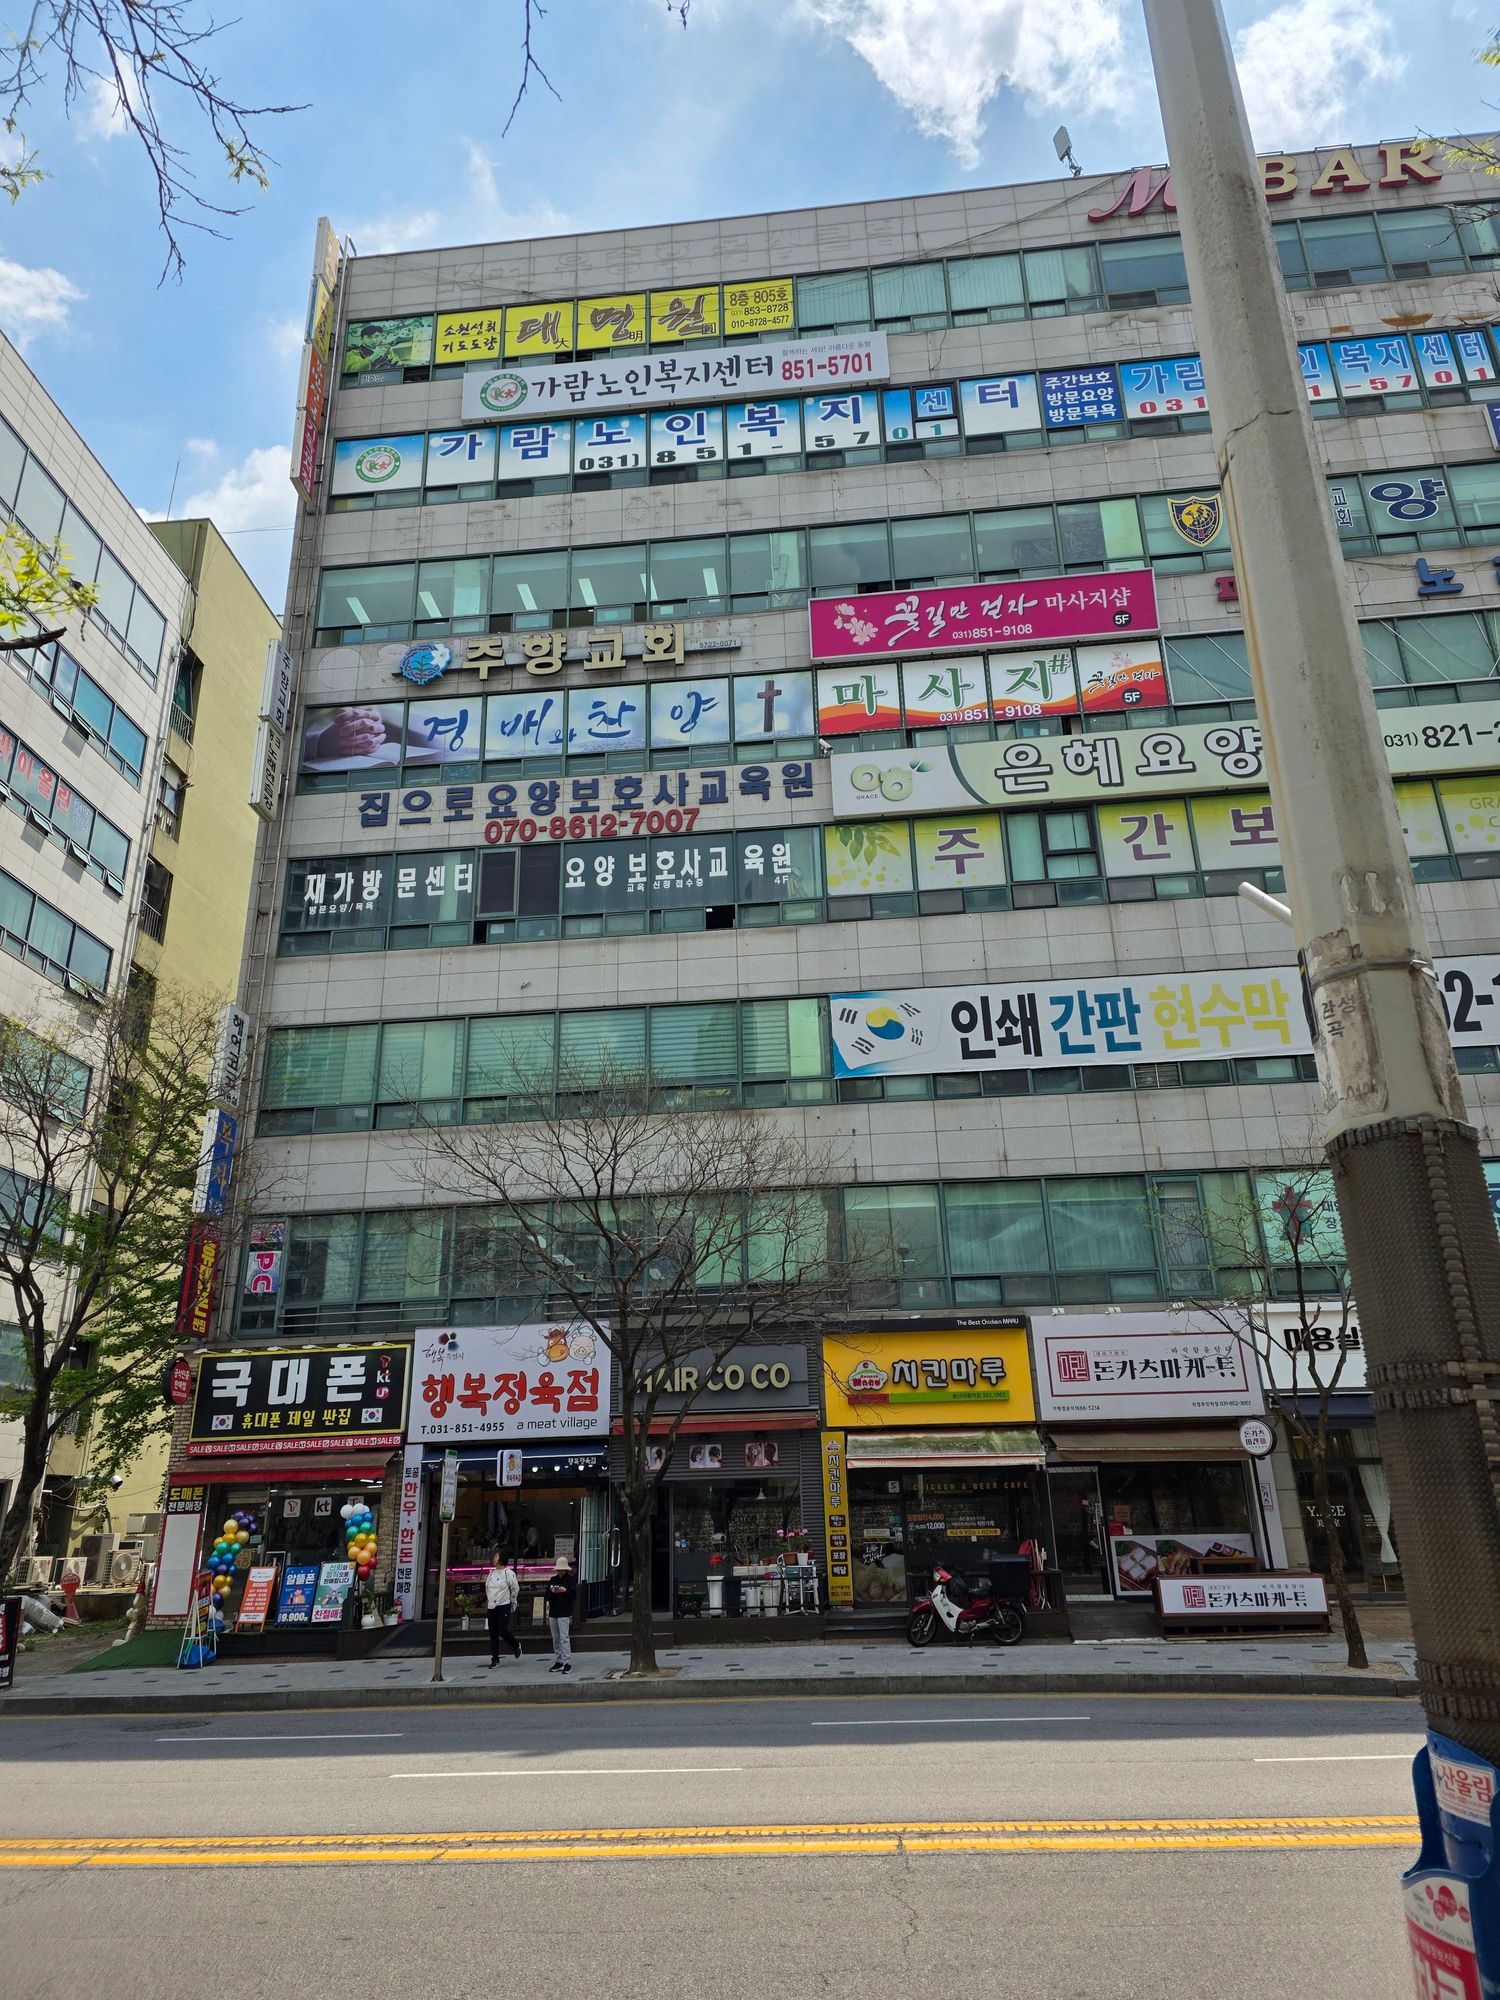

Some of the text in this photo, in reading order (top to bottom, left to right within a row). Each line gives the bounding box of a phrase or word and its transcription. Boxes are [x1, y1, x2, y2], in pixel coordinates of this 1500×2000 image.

[1257, 143, 1443, 201] BAR
[729, 287, 789, 307] 8층 805호
[731, 314, 790, 329] 010-8728-4577
[781, 351, 873, 381] 851-5701
[532, 354, 774, 403] 가람노인복지센터
[1044, 371, 1113, 390] 주간보호
[1046, 387, 1115, 406] 방문요양
[1049, 403, 1117, 423] 방문목욕
[1044, 587, 1132, 612] 마사지샵
[1114, 613, 1129, 625] 5F
[462, 623, 686, 681] 주향교회
[1124, 692, 1140, 703] 5F
[483, 807, 701, 844] 070-8612-7007
[774, 874, 789, 885] 4F
[950, 977, 1291, 1060] 인쇄 간판 현수막
[251, 1252, 276, 1293] PC
[967, 1318, 981, 1326] Best
[211, 1355, 366, 1407] 국대폰
[376, 1370, 391, 1383] kt
[891, 1357, 1007, 1389] 치킨마루
[421, 1367, 600, 1419] 행복정육점
[241, 1407, 352, 1429] 휴대폰 제일 싼집
[420, 1415, 598, 1435] T.031-851-4955 a meat village
[213, 1444, 228, 1452] SALE
[237, 1443, 251, 1451] SALE
[260, 1442, 275, 1450] SALE
[283, 1441, 298, 1449] SALE
[307, 1440, 321, 1448] SALE
[330, 1439, 345, 1447] SALE
[354, 1438, 369, 1446] SALE
[378, 1437, 392, 1445] SALE
[170, 1487, 204, 1501] 도매폰
[168, 1501, 203, 1512] 전문매장
[316, 1500, 331, 1513] kt
[286, 1573, 315, 1585] 알뜰폰
[1441, 1764, 1491, 1803] 산울림
